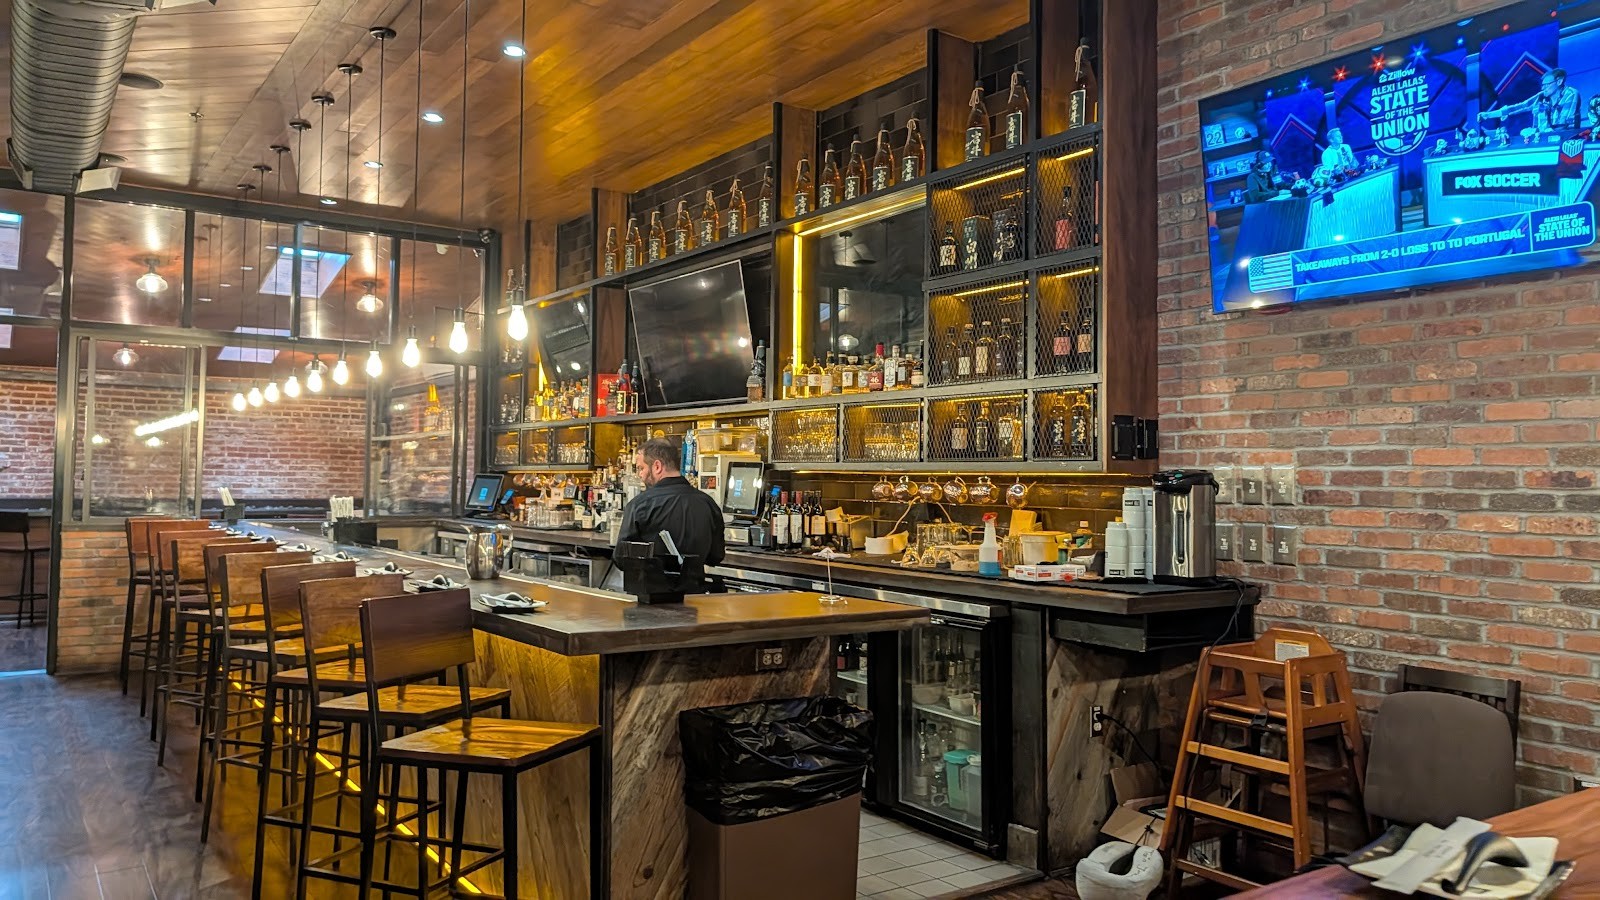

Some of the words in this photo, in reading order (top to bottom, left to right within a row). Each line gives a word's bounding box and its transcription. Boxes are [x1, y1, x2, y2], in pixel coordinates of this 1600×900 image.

[1387, 68, 1415, 81] Zillow
[1372, 83, 1395, 97] ALEXI
[1370, 84, 1429, 114] STATE
[1385, 111, 1395, 120] OF
[1396, 106, 1414, 117] THE
[1371, 111, 1430, 140] UNION
[1206, 132, 1222, 146] 22
[1455, 175, 1482, 189] FOX
[1484, 172, 1541, 188] SOCCER
[1539, 220, 1570, 232] STATE
[1571, 217, 1585, 227] OF
[1534, 231, 1555, 242] THE
[1556, 225, 1590, 238] UNION
[1295, 256, 1350, 272] TAKEAWAYS
[1351, 251, 1380, 264] FROM
[1381, 247, 1400, 259] 2-0
[1401, 243, 1429, 256] LOSS
[1430, 241, 1446, 251] TO
[1447, 237, 1463, 249] TO
[1464, 228, 1526, 246] PORTUGAL
[870, 376, 880, 384] 46
